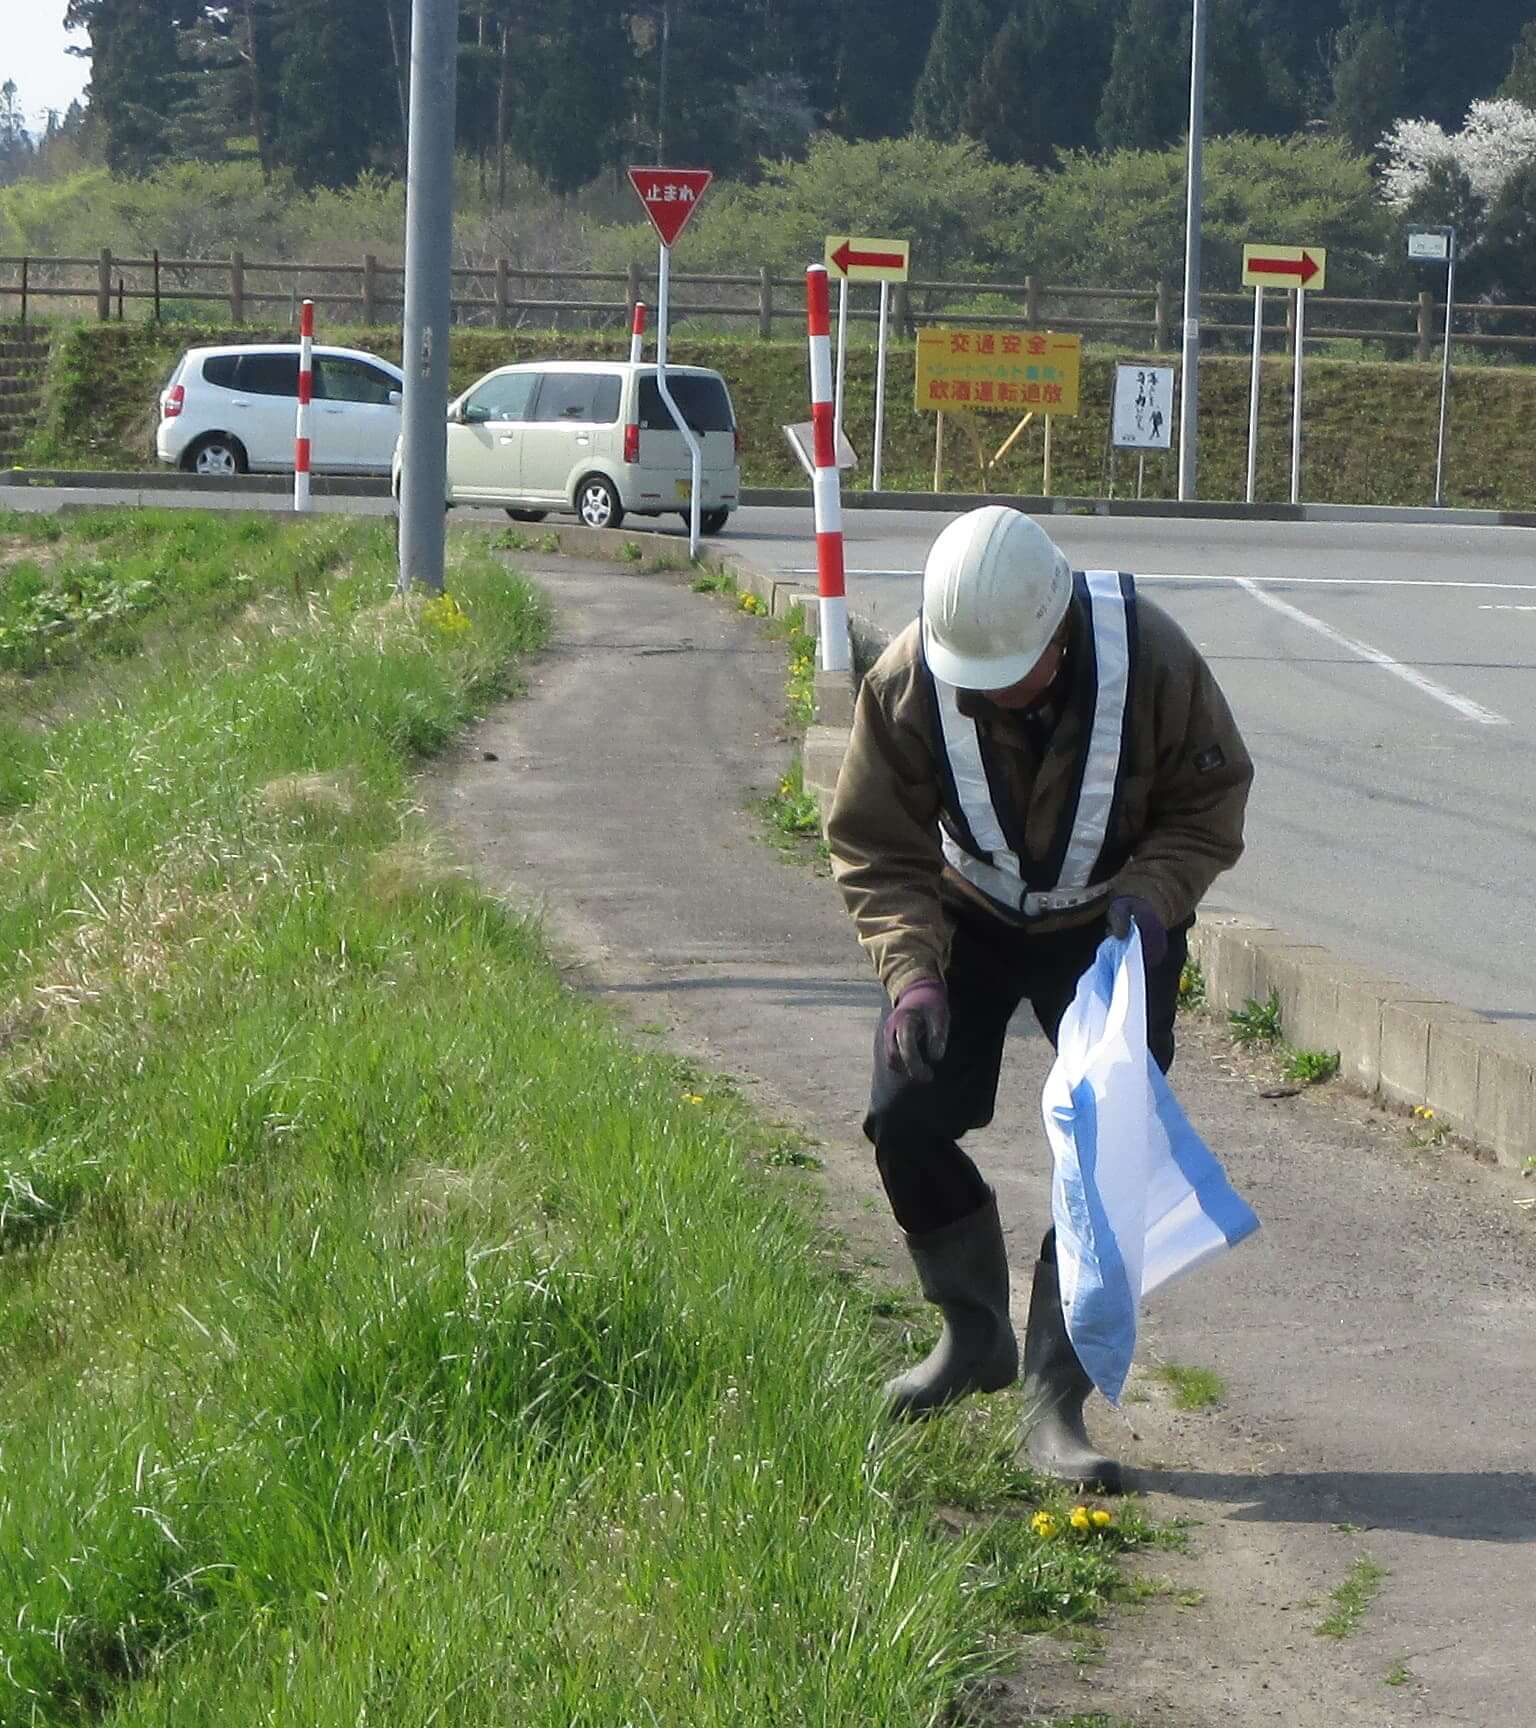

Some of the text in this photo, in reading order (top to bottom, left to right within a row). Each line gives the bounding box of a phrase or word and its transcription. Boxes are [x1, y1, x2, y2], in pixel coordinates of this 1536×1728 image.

[645, 184, 696, 202] 止まれ
[950, 333, 1047, 355] 交通安全
[929, 379, 1062, 403] 飲酒運転追放
